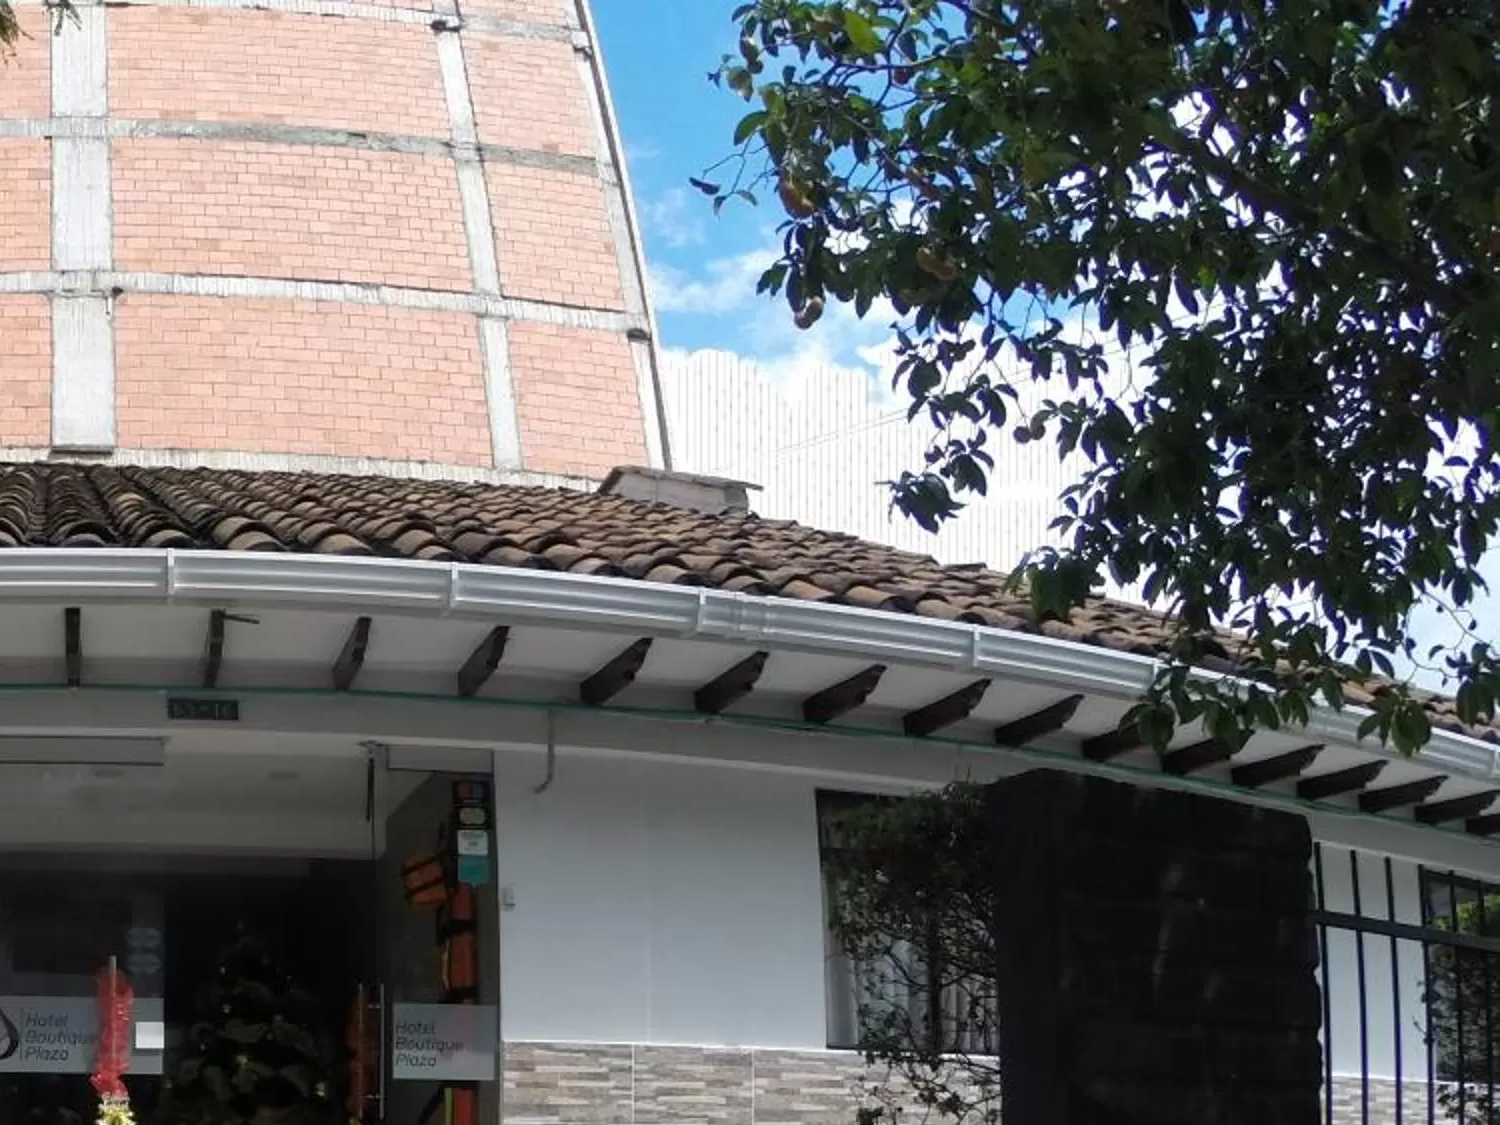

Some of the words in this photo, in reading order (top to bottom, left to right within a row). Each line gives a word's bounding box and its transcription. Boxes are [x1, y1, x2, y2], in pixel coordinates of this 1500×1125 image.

[24, 1012, 69, 1027] Hotel
[396, 1019, 437, 1034] Hotel
[24, 1045, 69, 1061] Plaza
[396, 1052, 437, 1067] Plaza
